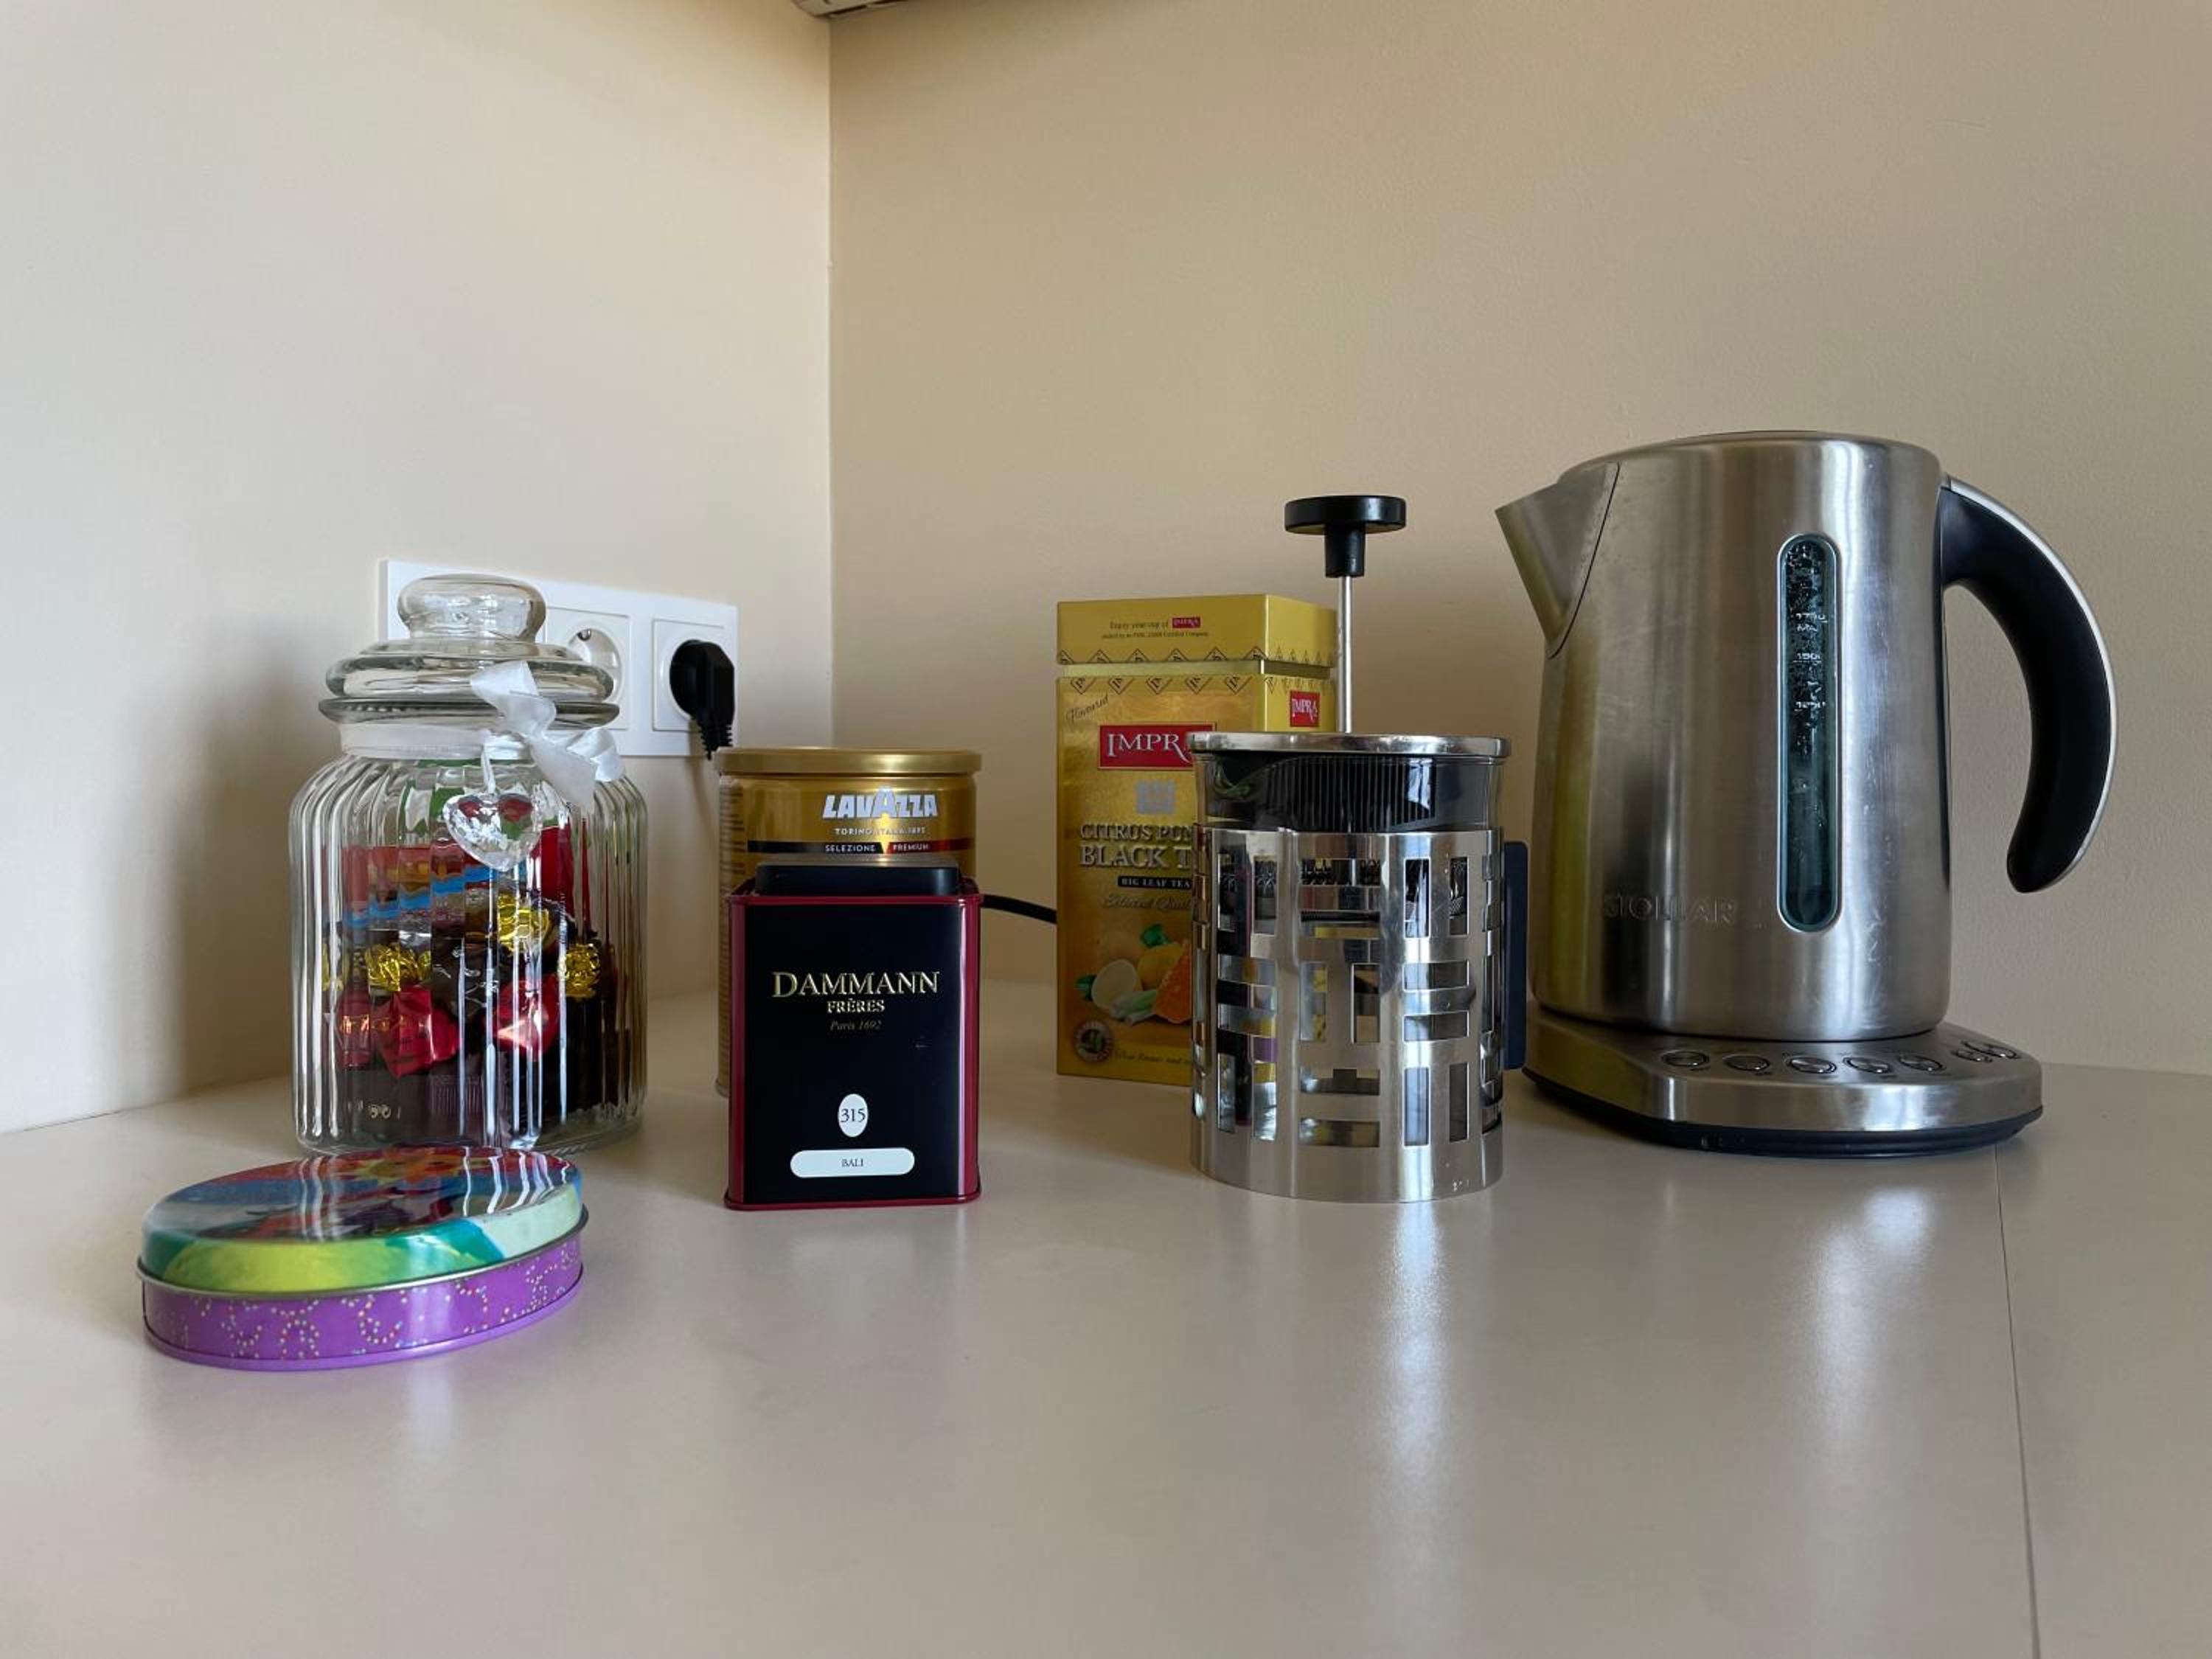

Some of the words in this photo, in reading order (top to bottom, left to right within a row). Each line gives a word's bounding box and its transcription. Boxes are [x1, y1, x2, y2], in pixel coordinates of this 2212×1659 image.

[1107, 732, 1192, 764] IMPR
[822, 786, 938, 818] LAVAZZA
[835, 827, 872, 835] TORINO
[1080, 824, 1152, 841] CITRUS
[1155, 825, 1192, 843] PUN
[825, 844, 876, 852] SELEZIONE
[893, 844, 929, 852] PREMIUM
[1080, 846, 1169, 869] BLACK
[772, 971, 940, 998] DAMMANN
[841, 1109, 866, 1123] 315
[841, 1159, 863, 1167] BALI
